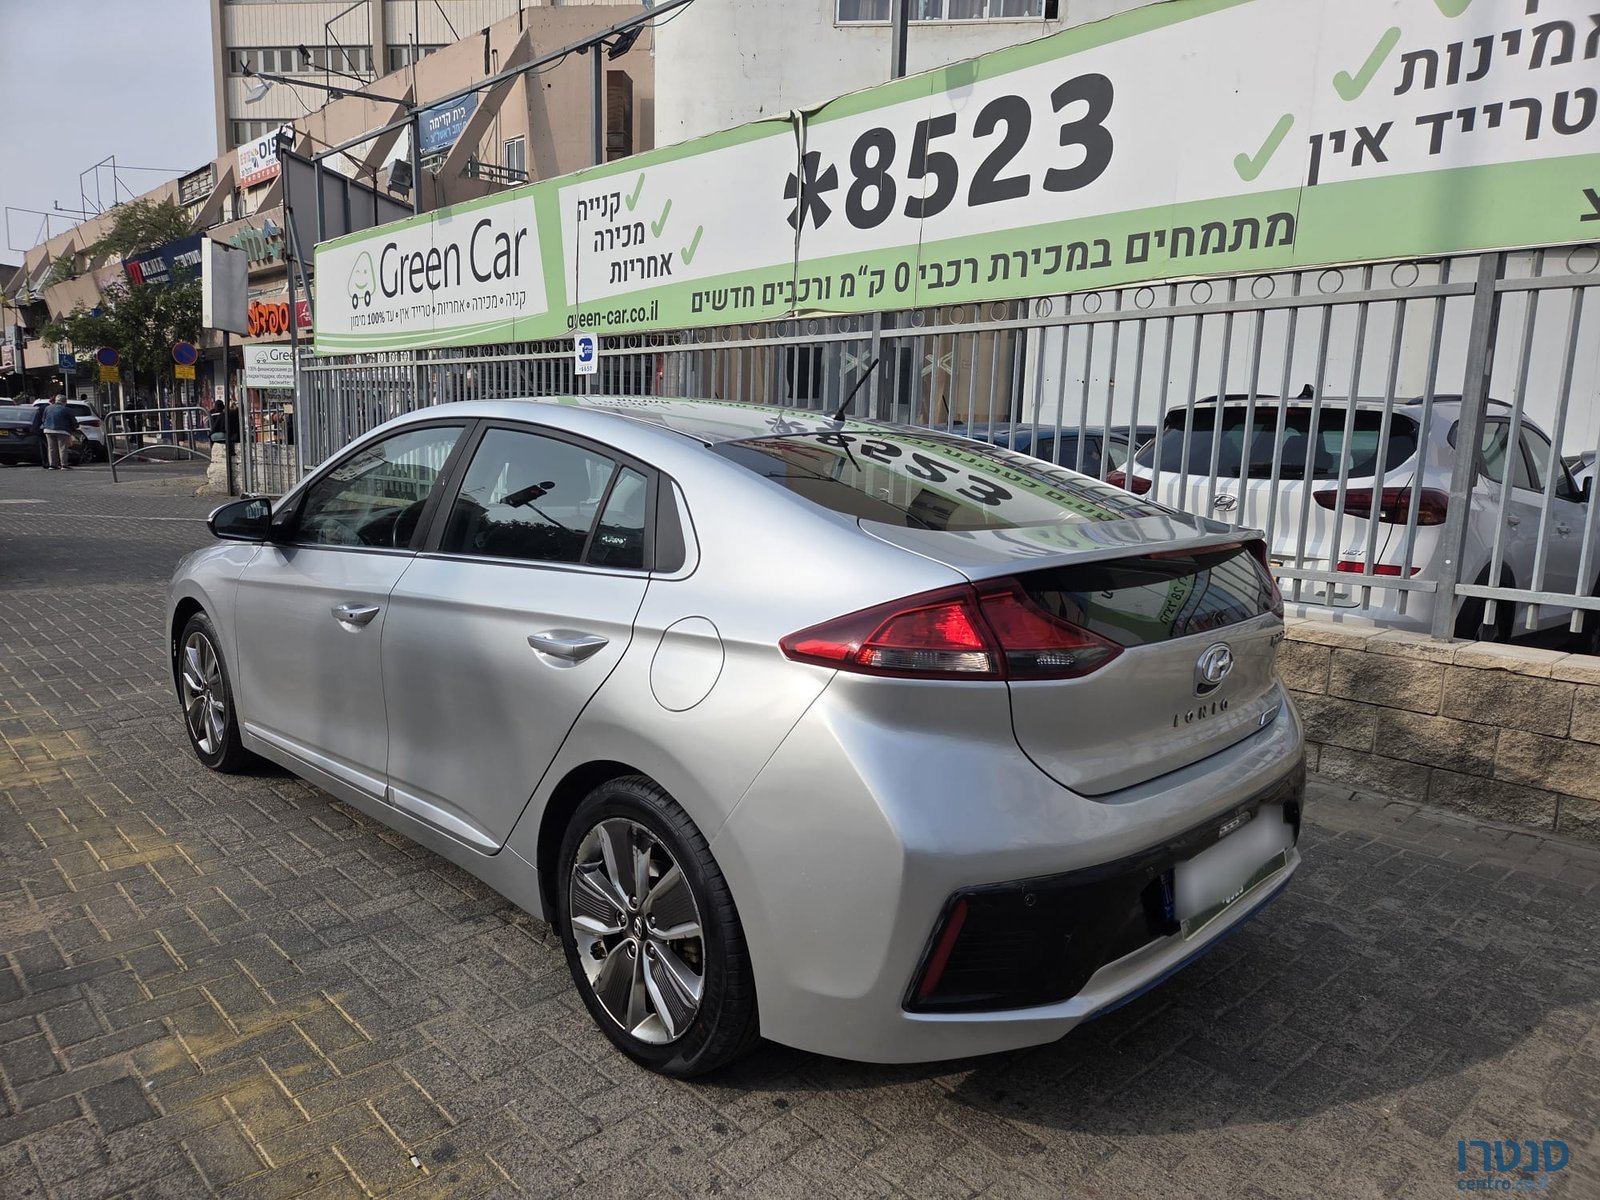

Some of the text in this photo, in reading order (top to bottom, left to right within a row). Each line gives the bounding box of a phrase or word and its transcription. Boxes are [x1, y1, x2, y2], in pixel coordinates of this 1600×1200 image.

[429, 112, 451, 131] קדימה
[1306, 86, 1599, 187] טרייד אין
[578, 191, 621, 223] קנייה
[593, 221, 645, 252] מכירה
[1126, 211, 1295, 265] מתמחים
[380, 218, 527, 299] Green Car
[609, 252, 673, 284] אחריות
[918, 256, 979, 290] רכבי
[987, 237, 1112, 282] במכירת
[762, 275, 831, 306] ורכבים
[894, 261, 910, 293] 0
[411, 304, 431, 319] טרייד
[437, 299, 465, 316] אחריות
[472, 294, 498, 311] מכירה
[505, 290, 526, 308] קניה
[691, 285, 755, 314] חדשים
[367, 312, 386, 325] 100%
[400, 307, 410, 324] אין
[269, 348, 294, 361] Gree
